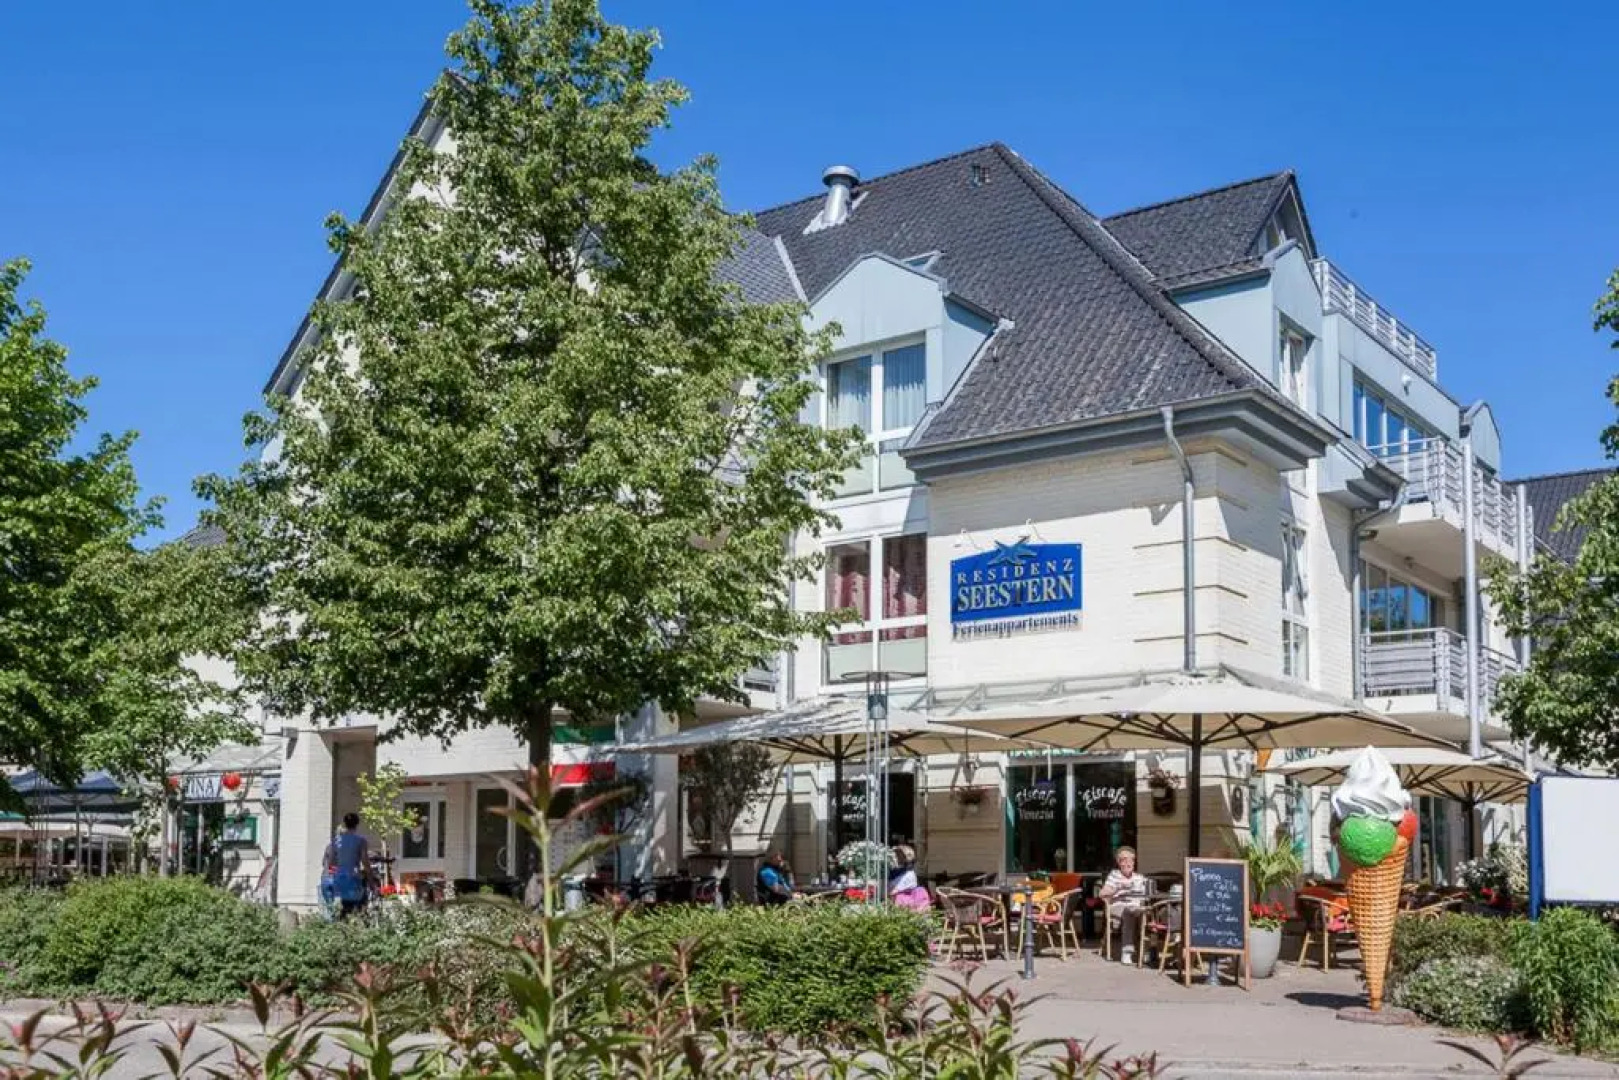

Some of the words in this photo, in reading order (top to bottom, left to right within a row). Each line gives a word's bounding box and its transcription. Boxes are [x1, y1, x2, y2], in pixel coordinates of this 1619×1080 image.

[957, 557, 1074, 584] RESIDENZ
[957, 574, 1075, 612] SEESTERN
[951, 613, 1079, 638] Ferienappartements
